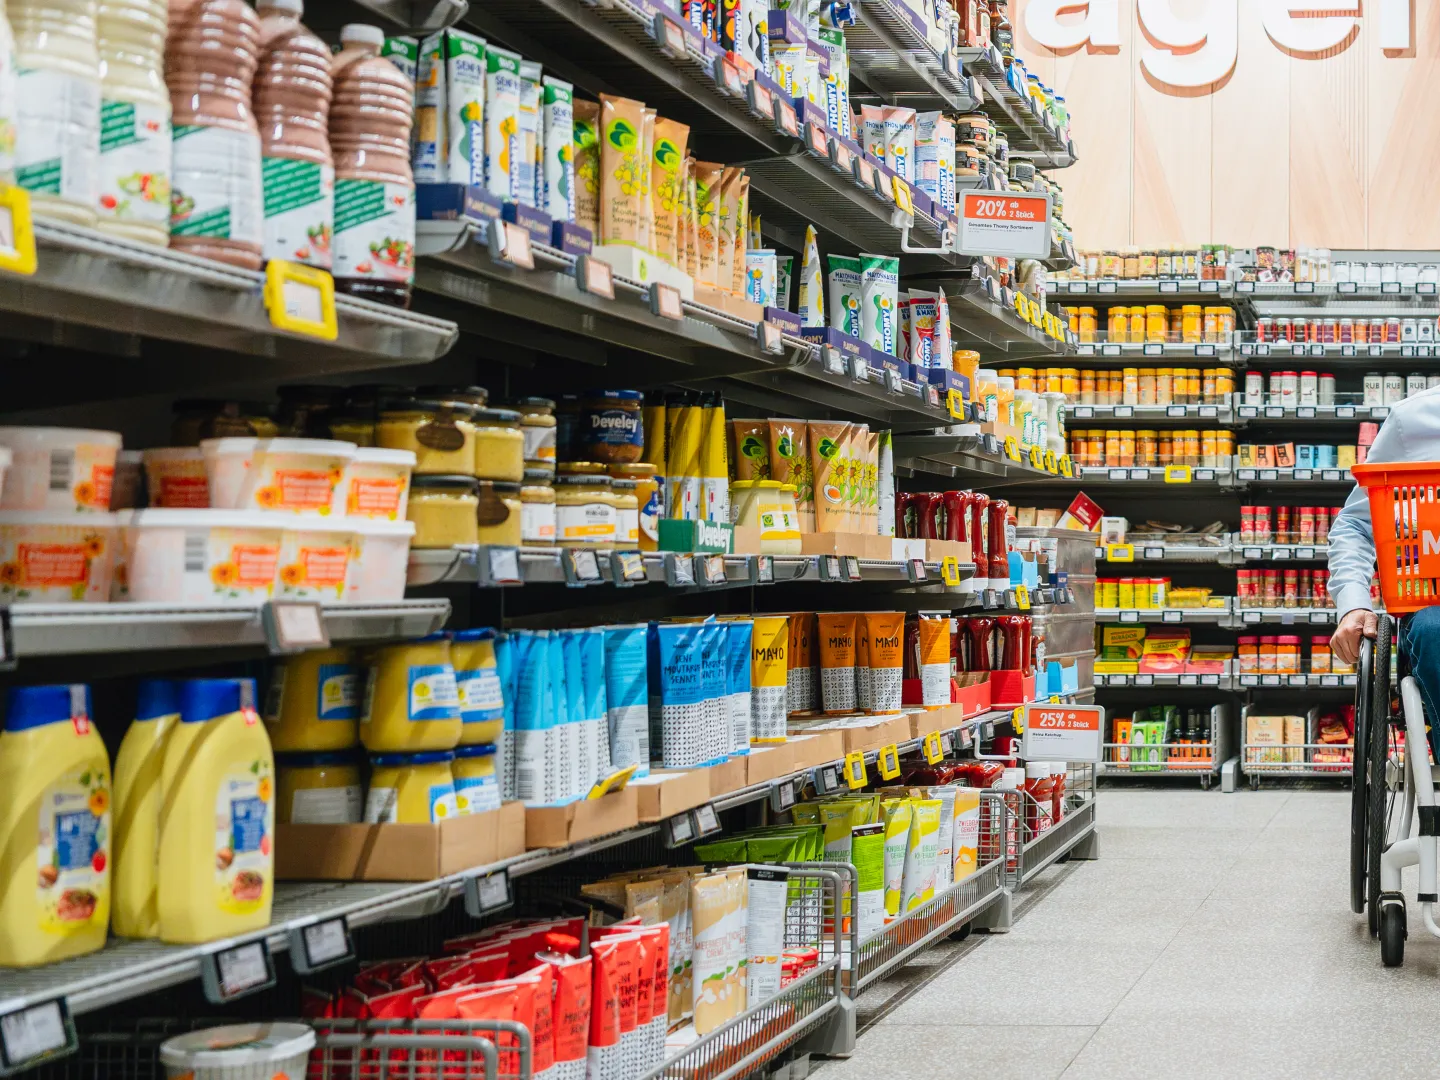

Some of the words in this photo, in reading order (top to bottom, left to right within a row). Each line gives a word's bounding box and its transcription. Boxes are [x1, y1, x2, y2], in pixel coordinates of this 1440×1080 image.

[827, 84, 838, 132] THOMY
[976, 200, 1007, 217] 20%
[1015, 211, 1035, 219] Stück
[883, 309, 893, 353] THOMY
[591, 414, 639, 433] Develey
[698, 520, 733, 553] Develey
[829, 637, 853, 648] MAYO
[875, 636, 899, 648] MAYO
[755, 648, 784, 661] MAYO
[1040, 712, 1065, 727] 25%
